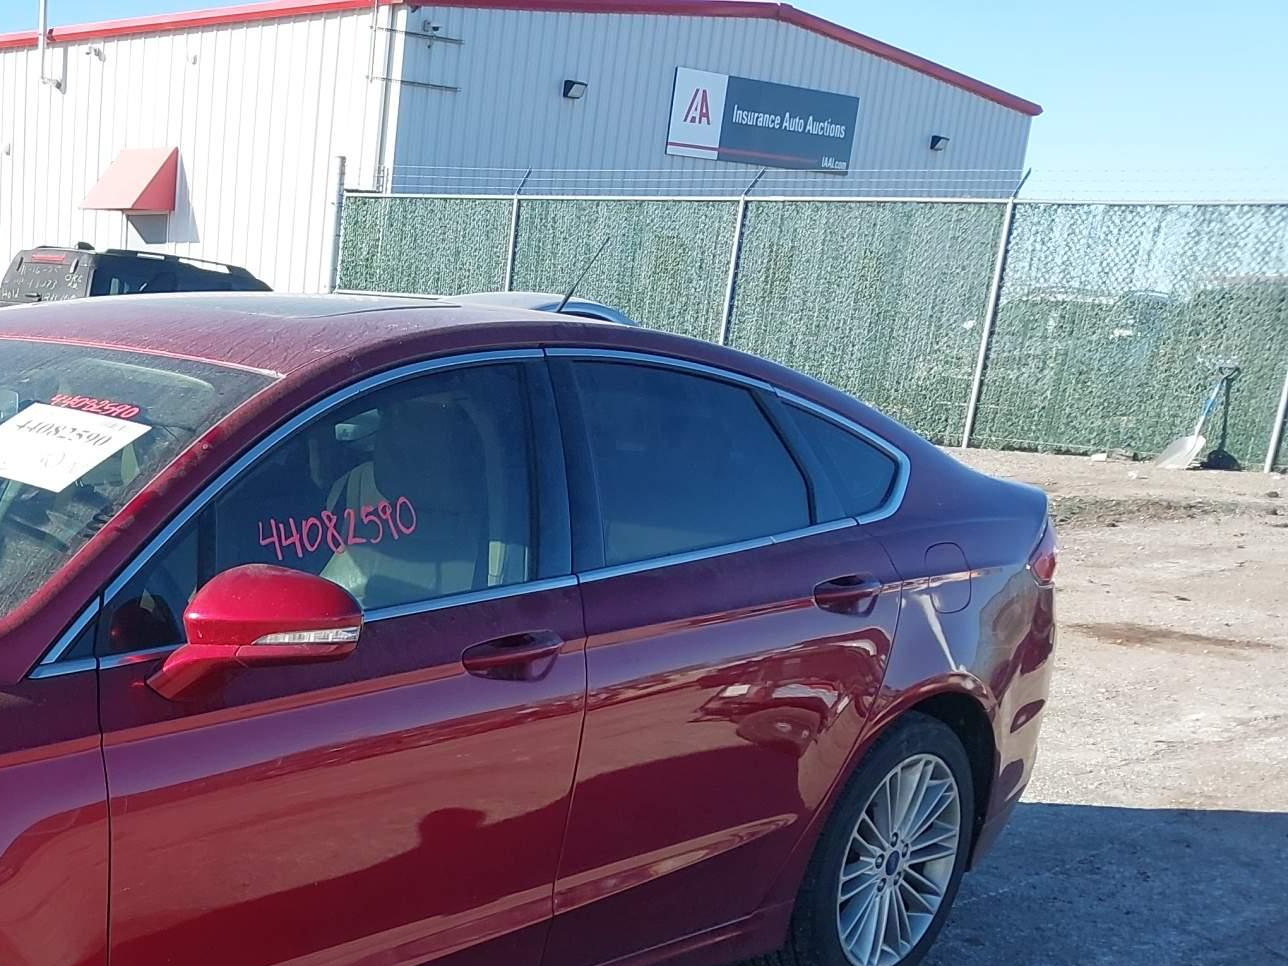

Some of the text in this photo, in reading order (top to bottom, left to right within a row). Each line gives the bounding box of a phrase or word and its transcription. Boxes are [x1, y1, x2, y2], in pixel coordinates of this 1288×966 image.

[732, 104, 846, 139] Insurance Auto Auctions
[51, 394, 140, 418] 44082590
[258, 496, 417, 561] 44082590
